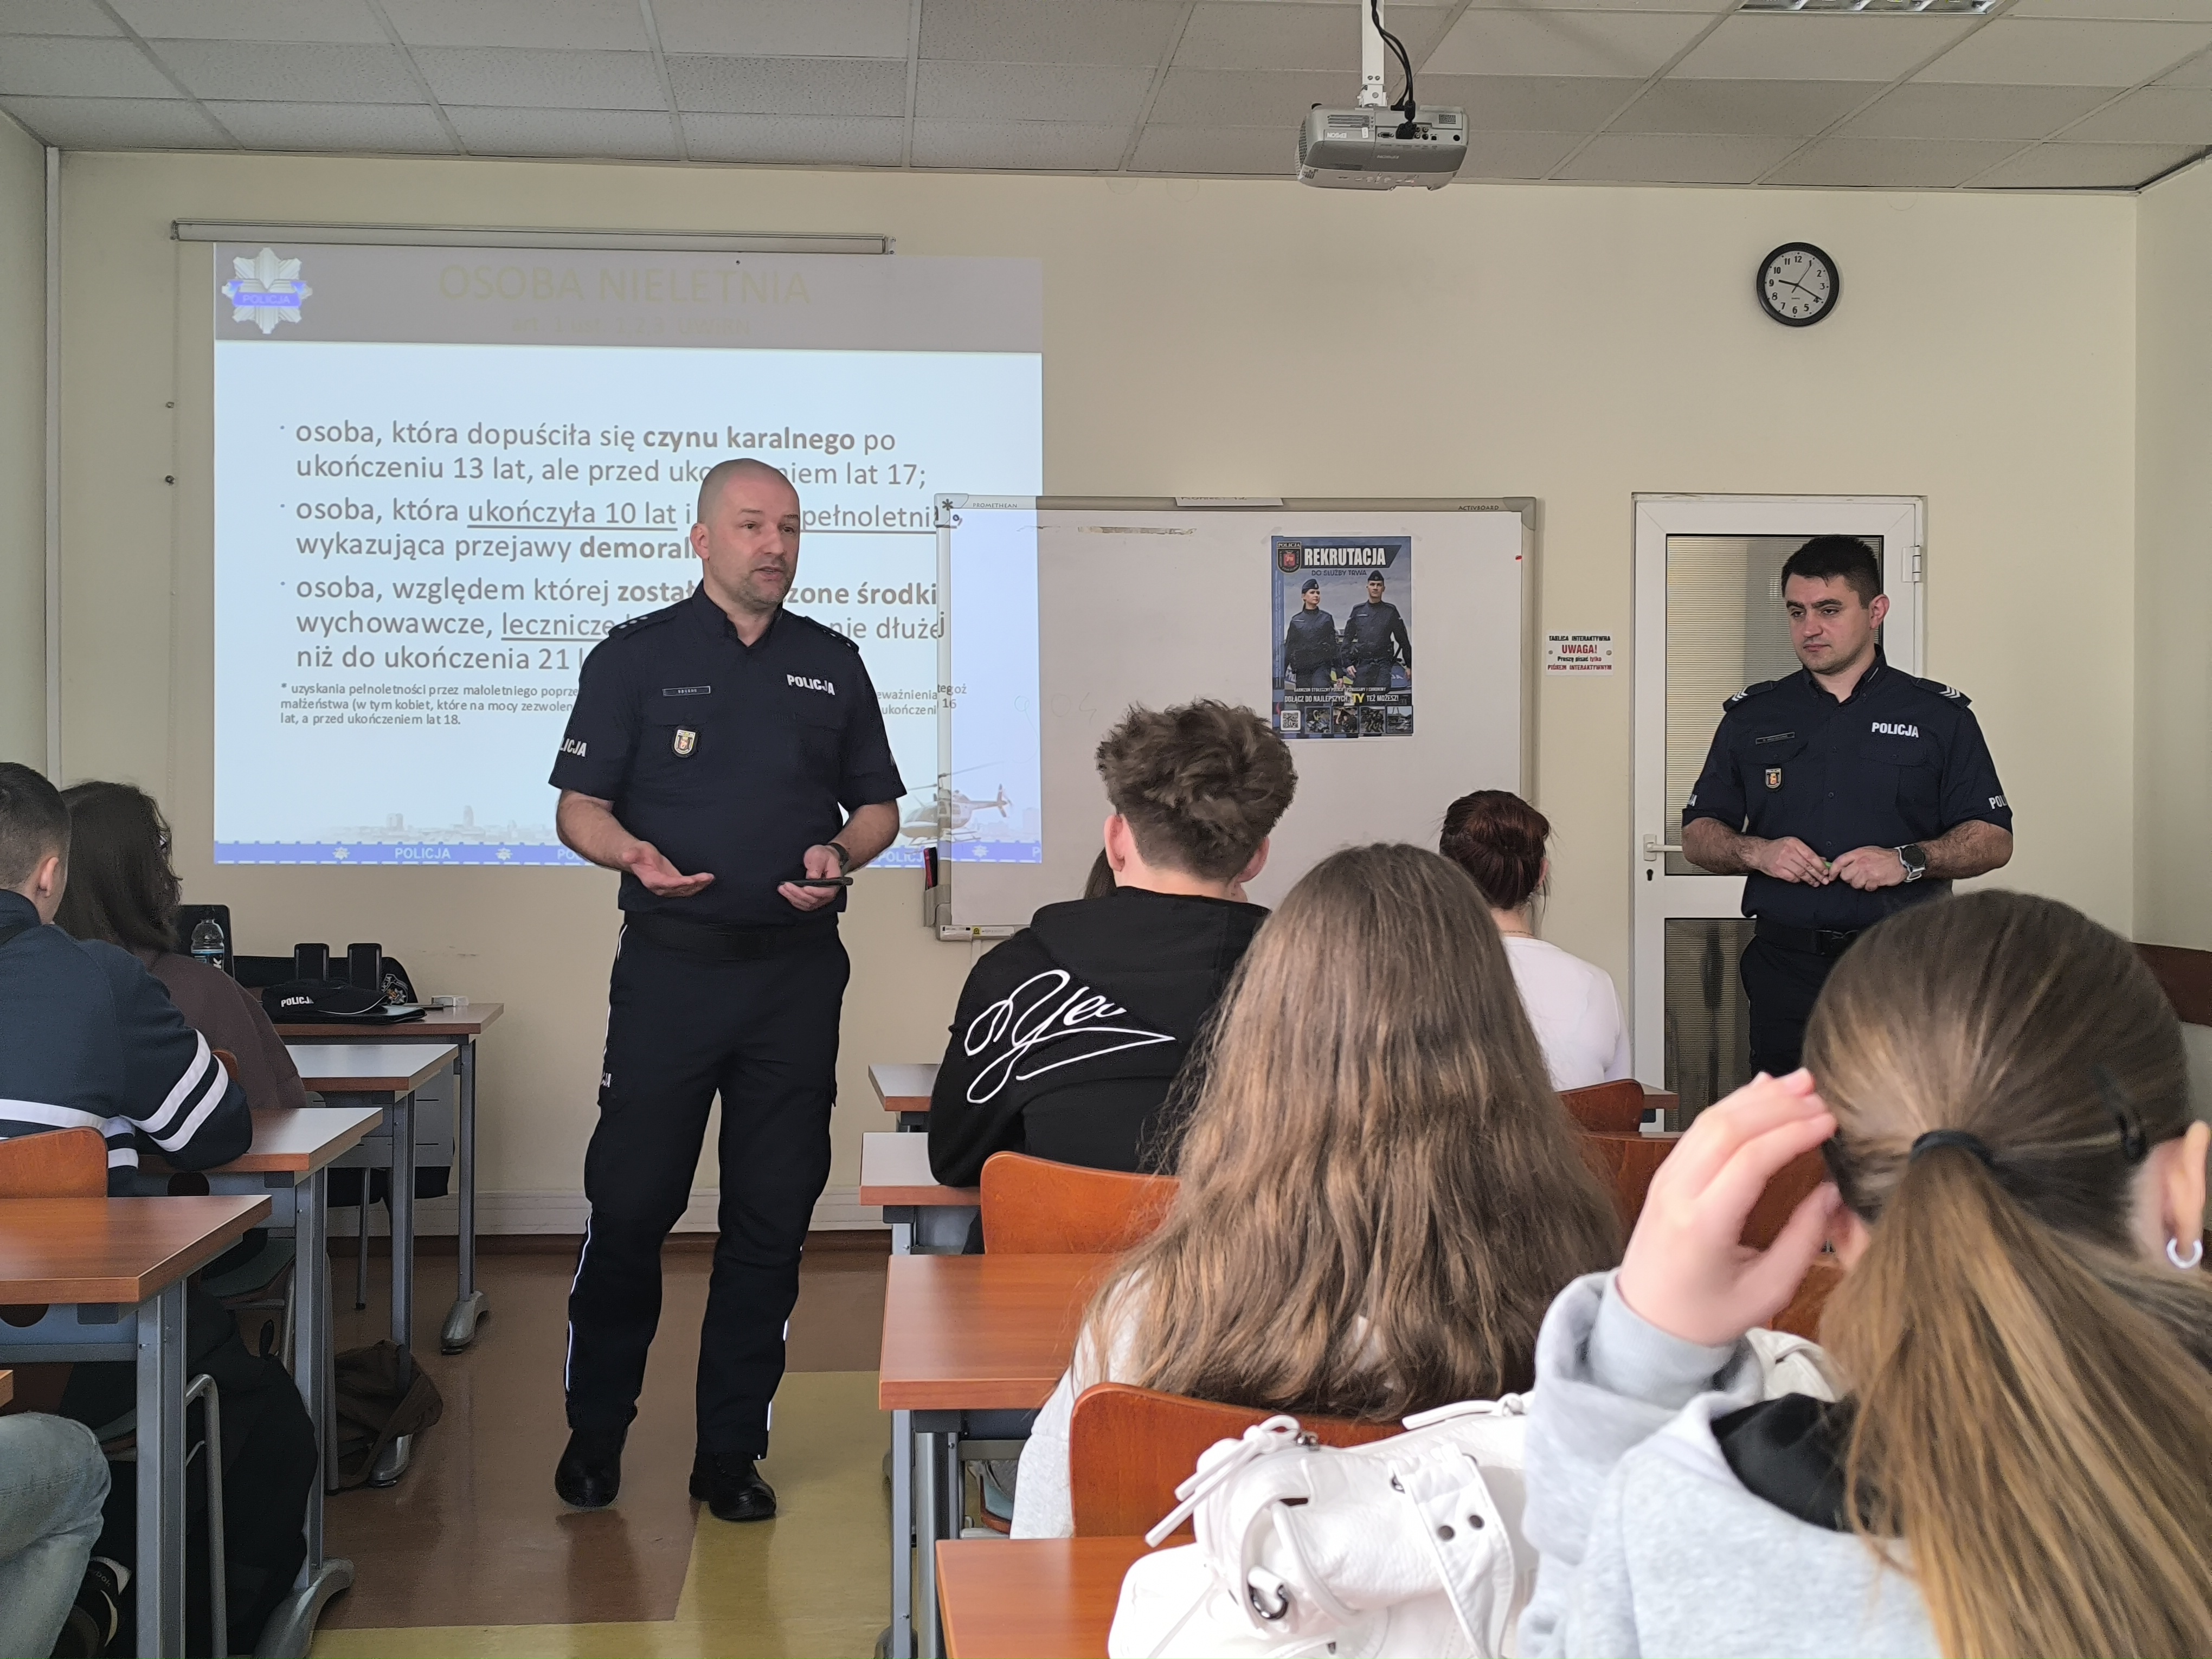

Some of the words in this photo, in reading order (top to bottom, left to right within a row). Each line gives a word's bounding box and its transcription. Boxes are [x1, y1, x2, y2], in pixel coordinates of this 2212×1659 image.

[439, 263, 585, 300] OSOBA
[599, 266, 811, 305] NIELETNIA
[1769, 279, 1774, 287] 9
[242, 294, 290, 304] POLICJA
[1772, 292, 1778, 300] 8
[1804, 304, 1809, 312] 5
[297, 420, 381, 447] osoba,
[393, 420, 457, 443] która
[468, 422, 590, 450] dopuściła
[600, 425, 634, 452] się
[644, 431, 717, 452] czynu
[728, 426, 854, 454] karalnego
[865, 435, 895, 455] po
[298, 454, 442, 478] ukończeniu
[454, 458, 483, 478] 13
[494, 456, 532, 484] lat,
[542, 458, 578, 480] ale
[589, 459, 658, 486] przed
[847, 462, 878, 484] lat
[889, 464, 924, 489] 17;
[297, 497, 382, 524] osoba,
[394, 498, 458, 520] która
[468, 499, 595, 527] ukończyła
[607, 503, 635, 523] 10
[646, 501, 676, 524] lat
[296, 531, 443, 560] wykazująca
[456, 536, 571, 563] przejawy
[580, 536, 697, 559] demoral
[1304, 548, 1386, 566] REKRUTACJA
[297, 575, 382, 602] osoba,
[393, 576, 524, 605] względem
[535, 578, 608, 606] której
[858, 582, 937, 605] środki
[297, 610, 492, 638] wychowawcze,
[1562, 644, 1597, 654] UWAGA!
[298, 646, 332, 667] niż
[343, 645, 374, 667] do
[385, 645, 529, 669] ukończenia
[539, 648, 569, 670] 21
[292, 683, 345, 696] uzyskania
[349, 684, 426, 696] pełnoletności
[429, 687, 459, 697] przez
[464, 685, 537, 698] małoletniego
[787, 674, 835, 696] POLICJA
[281, 698, 348, 709] małżeństwa
[352, 698, 366, 711] (w
[370, 700, 392, 711] tym
[395, 699, 433, 711] kobiet,
[438, 699, 467, 710] które
[488, 703, 518, 713] mocy
[1353, 693, 1365, 704] TY
[281, 712, 298, 724] lat,
[313, 713, 343, 725] przed
[348, 713, 422, 724] ukończeniem
[427, 713, 441, 724] lat
[445, 715, 460, 724] 18.
[1872, 722, 1919, 738] POLICJA
[395, 847, 451, 860] POLICJA
